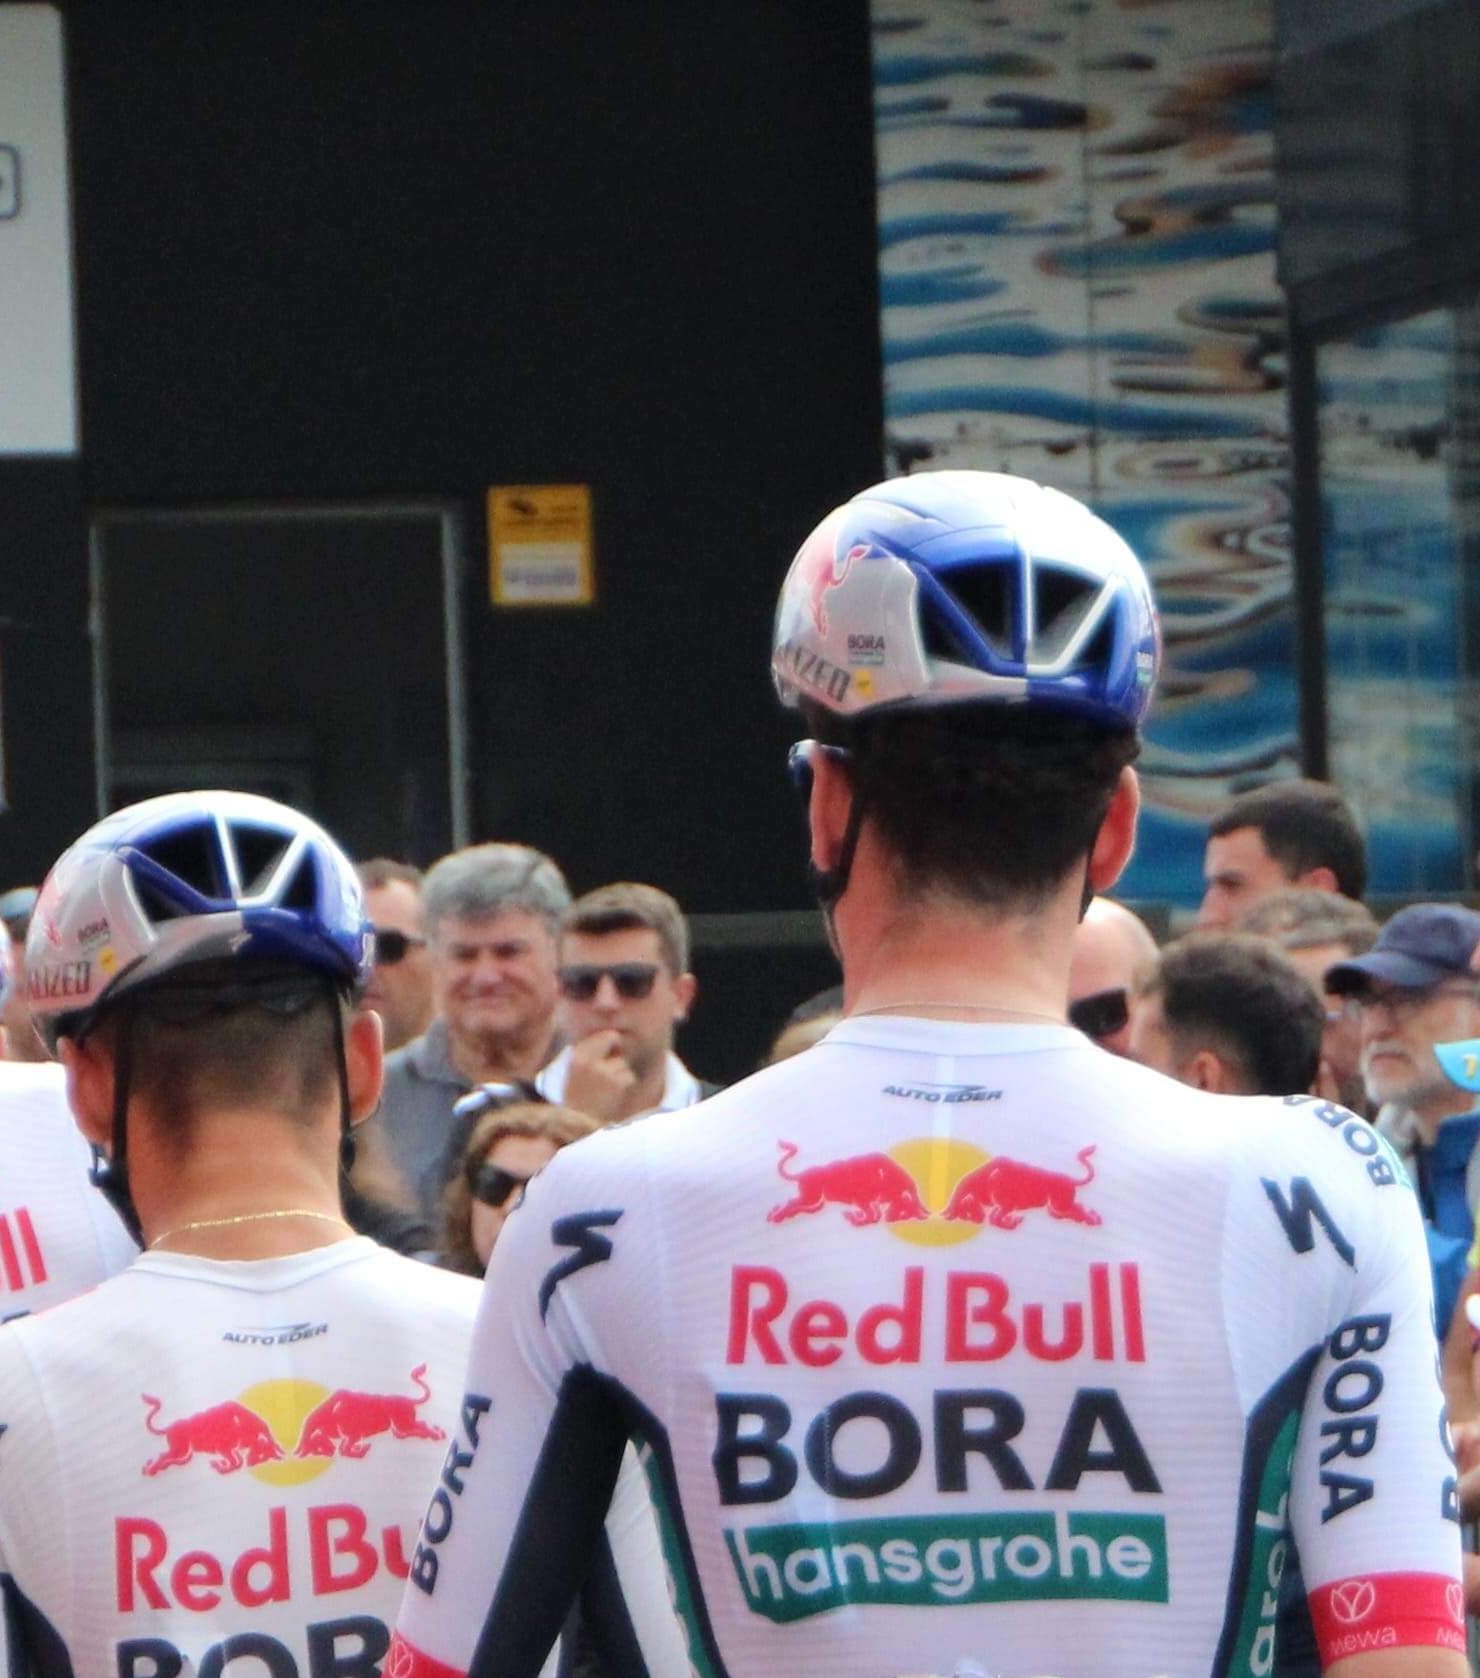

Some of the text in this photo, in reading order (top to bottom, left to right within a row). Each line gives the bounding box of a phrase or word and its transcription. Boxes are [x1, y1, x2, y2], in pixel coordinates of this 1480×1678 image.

[881, 1084, 1002, 1103] AUTO EDER
[224, 1322, 329, 1347] AUTO EDER
[725, 1261, 1148, 1369] Red Bull
[712, 1387, 1163, 1507] BORA
[1319, 1313, 1392, 1525] BORA
[410, 1393, 493, 1597] BORA
[116, 1503, 423, 1613] Red Bu
[725, 1512, 1154, 1602] hansgrohe
